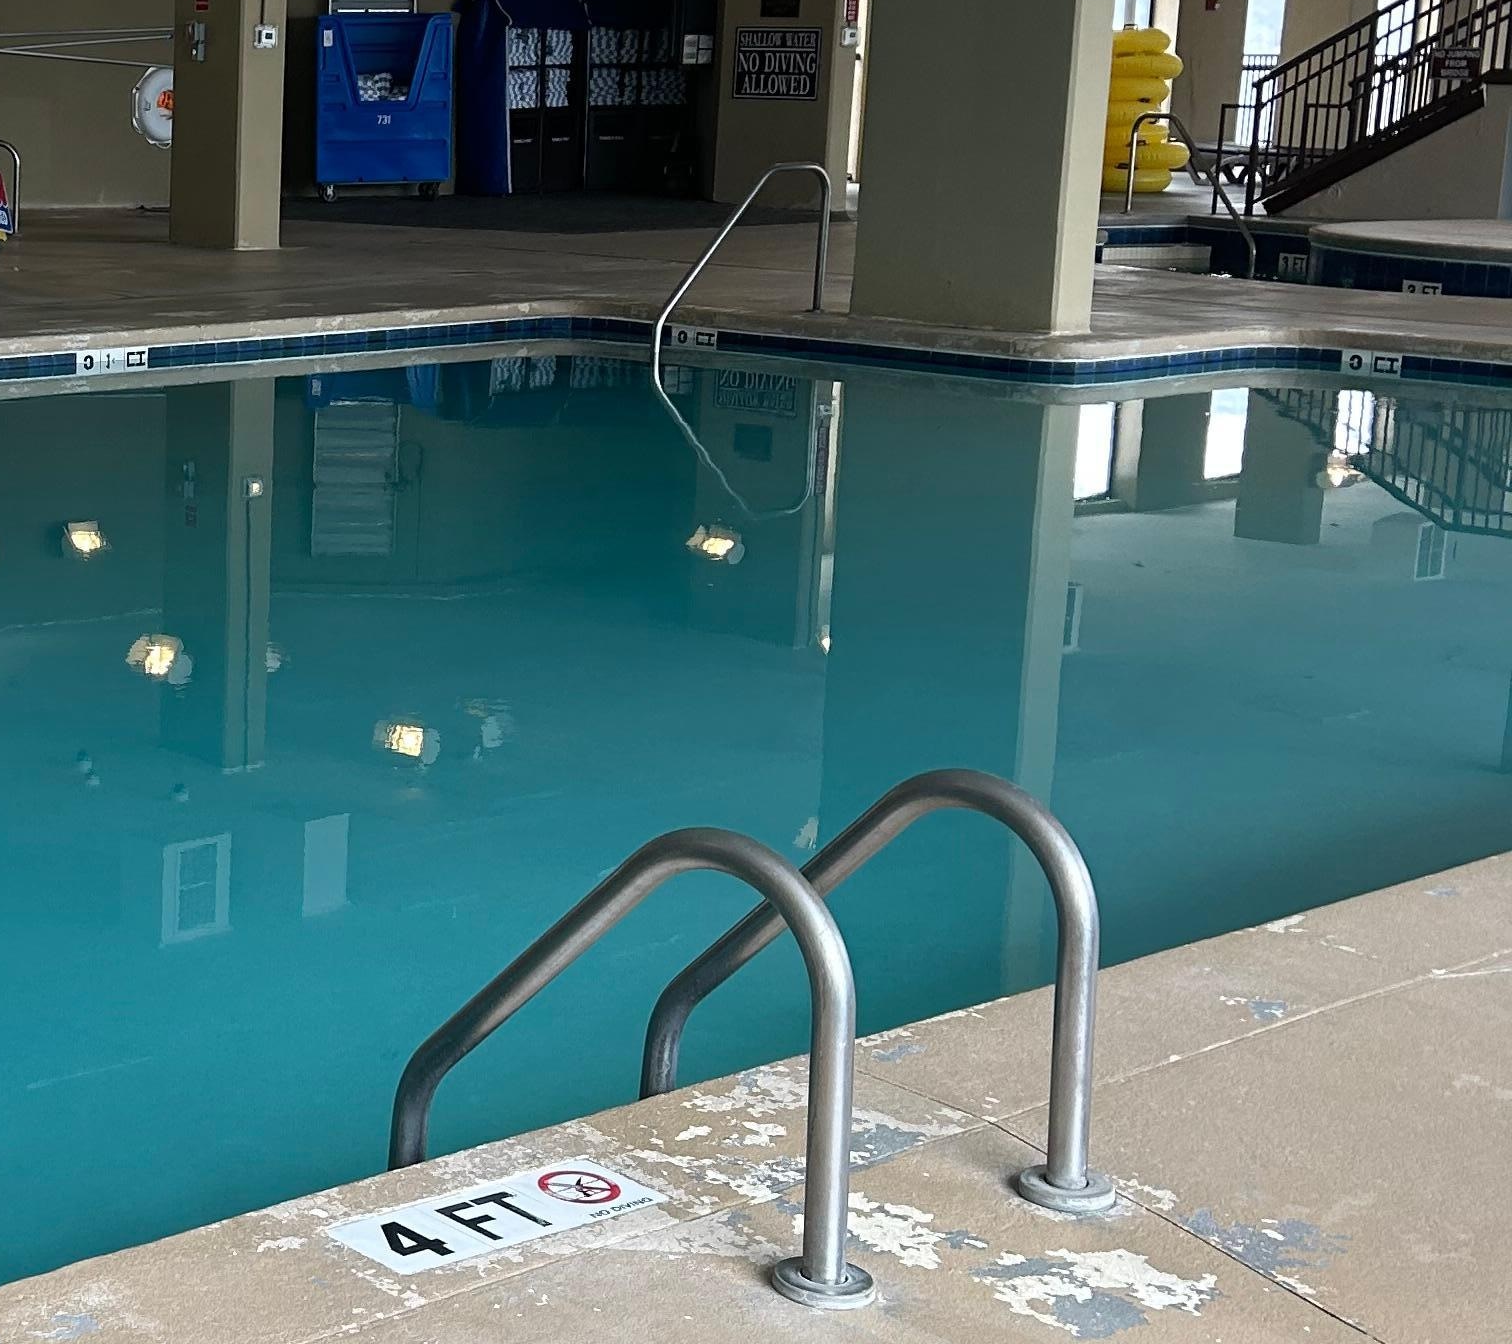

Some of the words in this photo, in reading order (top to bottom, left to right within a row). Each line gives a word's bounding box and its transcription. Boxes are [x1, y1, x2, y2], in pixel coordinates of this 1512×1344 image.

[740, 32, 783, 46] SHALLOW
[785, 32, 817, 47] WATER
[738, 52, 760, 72] NO
[764, 52, 816, 74] DIVING
[741, 74, 810, 94] ALLOWED
[589, 1209, 611, 1218] NO
[610, 1197, 654, 1212] DIVING
[380, 1221, 455, 1257] 4
[434, 1191, 553, 1241] FT
